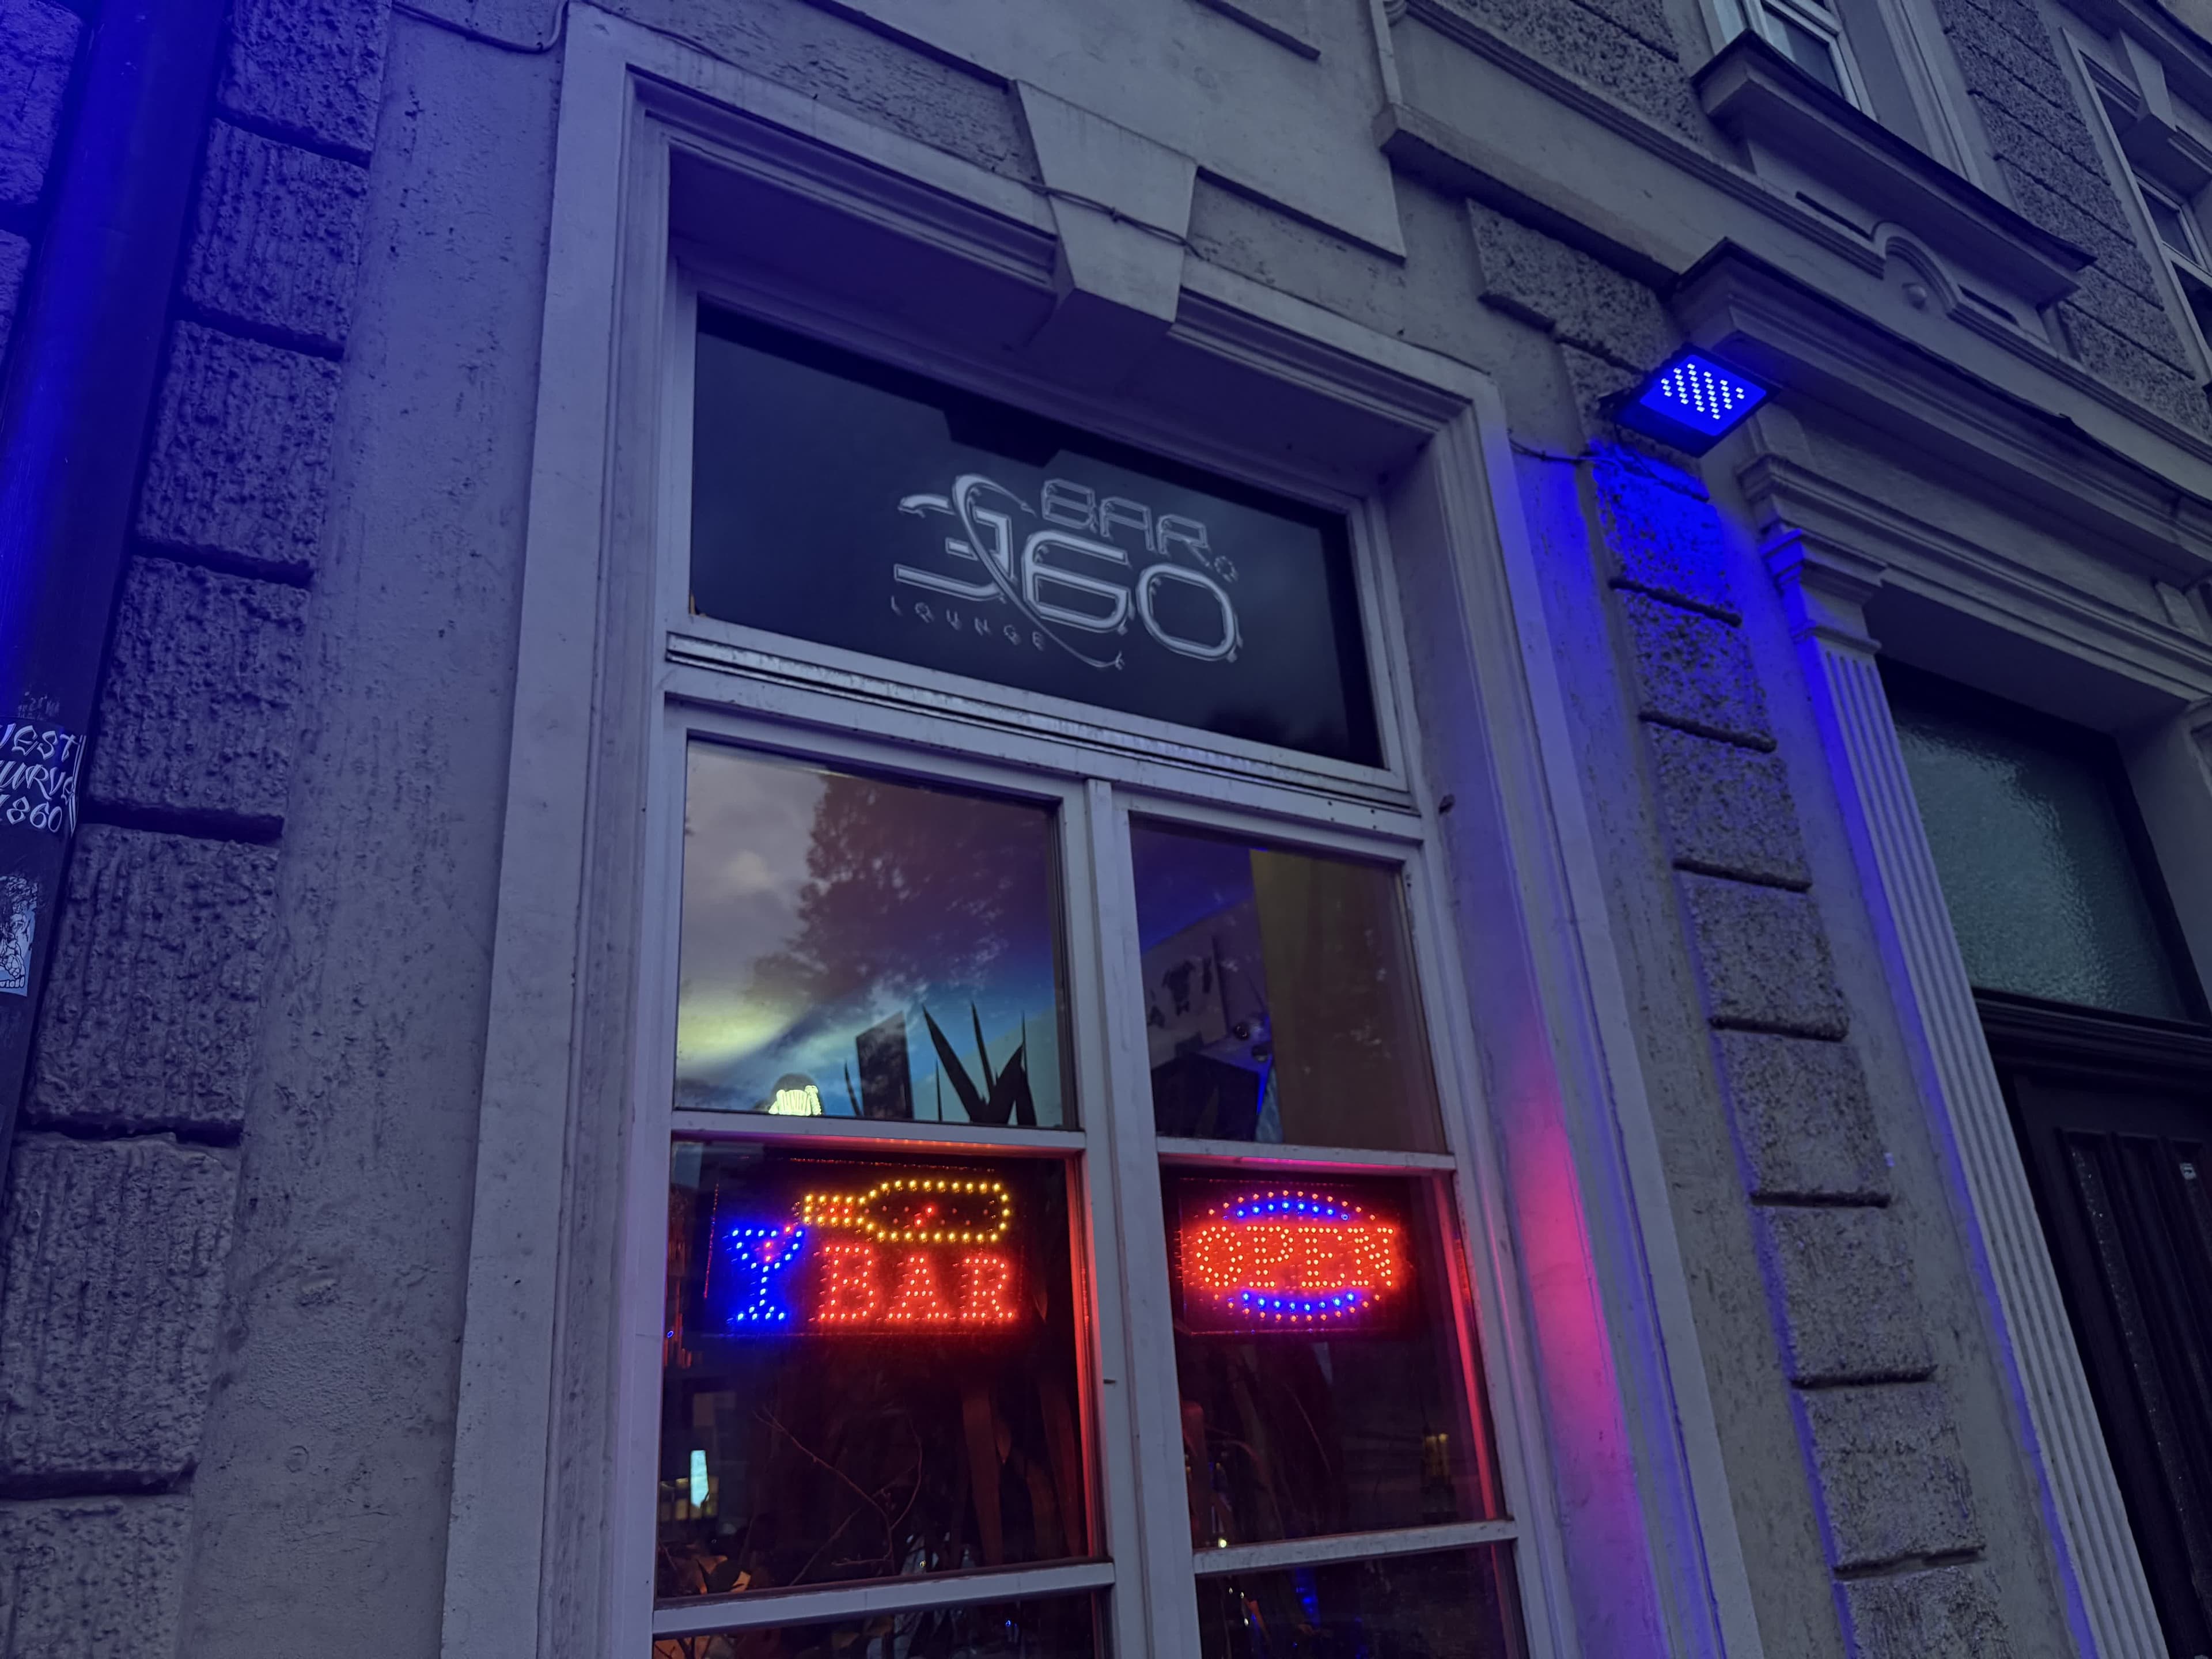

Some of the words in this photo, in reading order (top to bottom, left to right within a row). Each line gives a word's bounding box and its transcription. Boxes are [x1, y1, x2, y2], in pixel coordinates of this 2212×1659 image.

[1041, 478, 1212, 568] BAR
[890, 594, 1044, 651] LOUNGE
[818, 1244, 1015, 1321] BAR
[1196, 1225, 1395, 1288] OPEN
